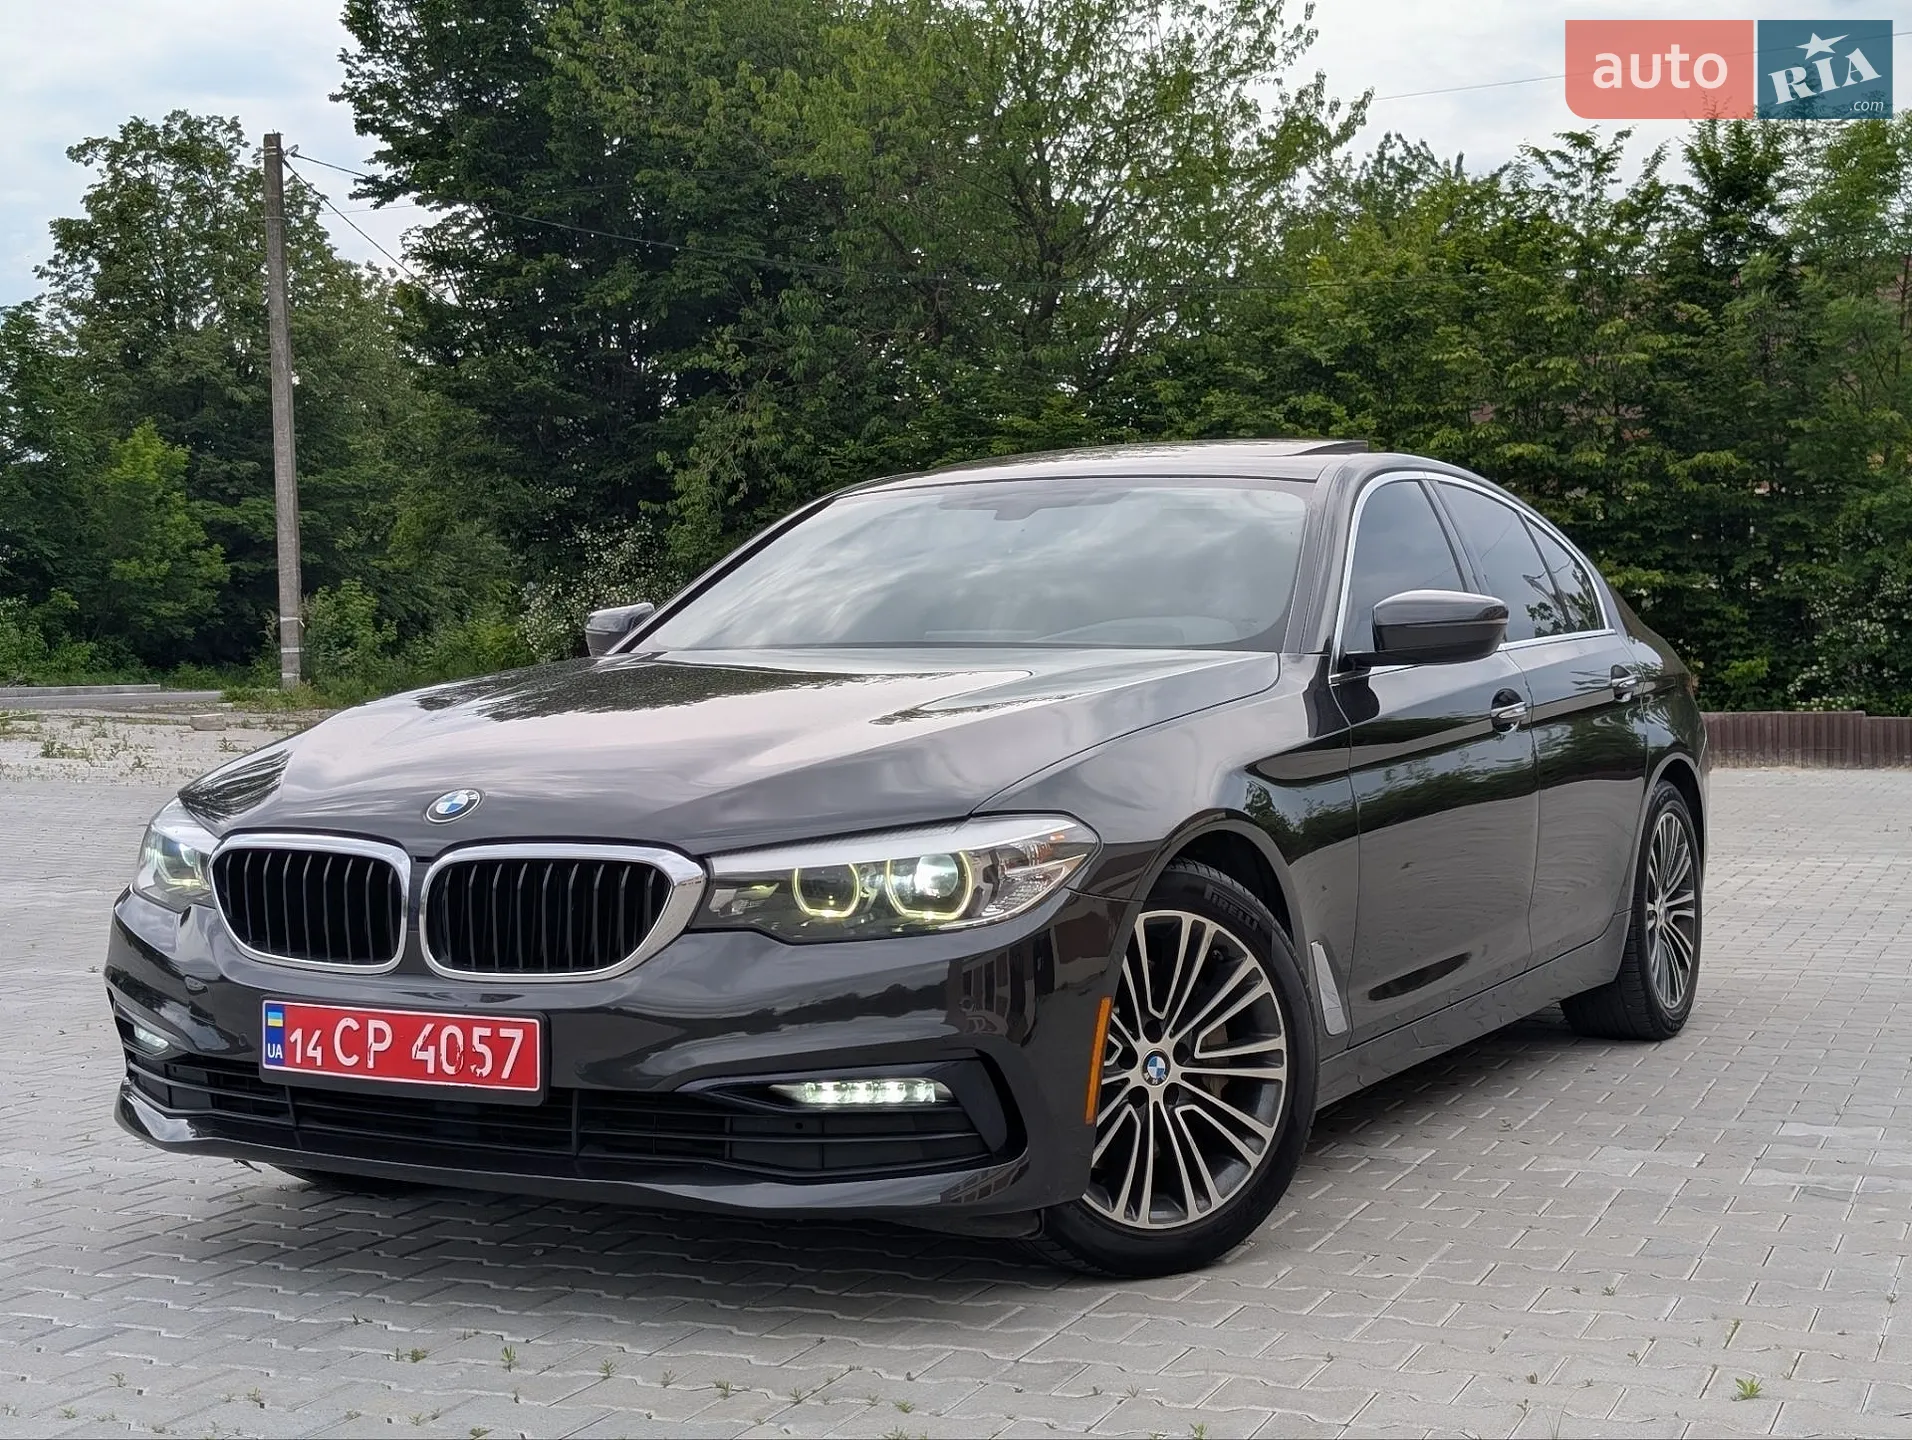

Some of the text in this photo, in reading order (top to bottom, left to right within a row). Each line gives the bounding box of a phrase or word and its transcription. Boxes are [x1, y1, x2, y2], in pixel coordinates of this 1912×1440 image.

[1204, 883, 1260, 932] PIRELLI
[267, 1043, 283, 1059] UA
[289, 1017, 524, 1079] 14 CP 4057
